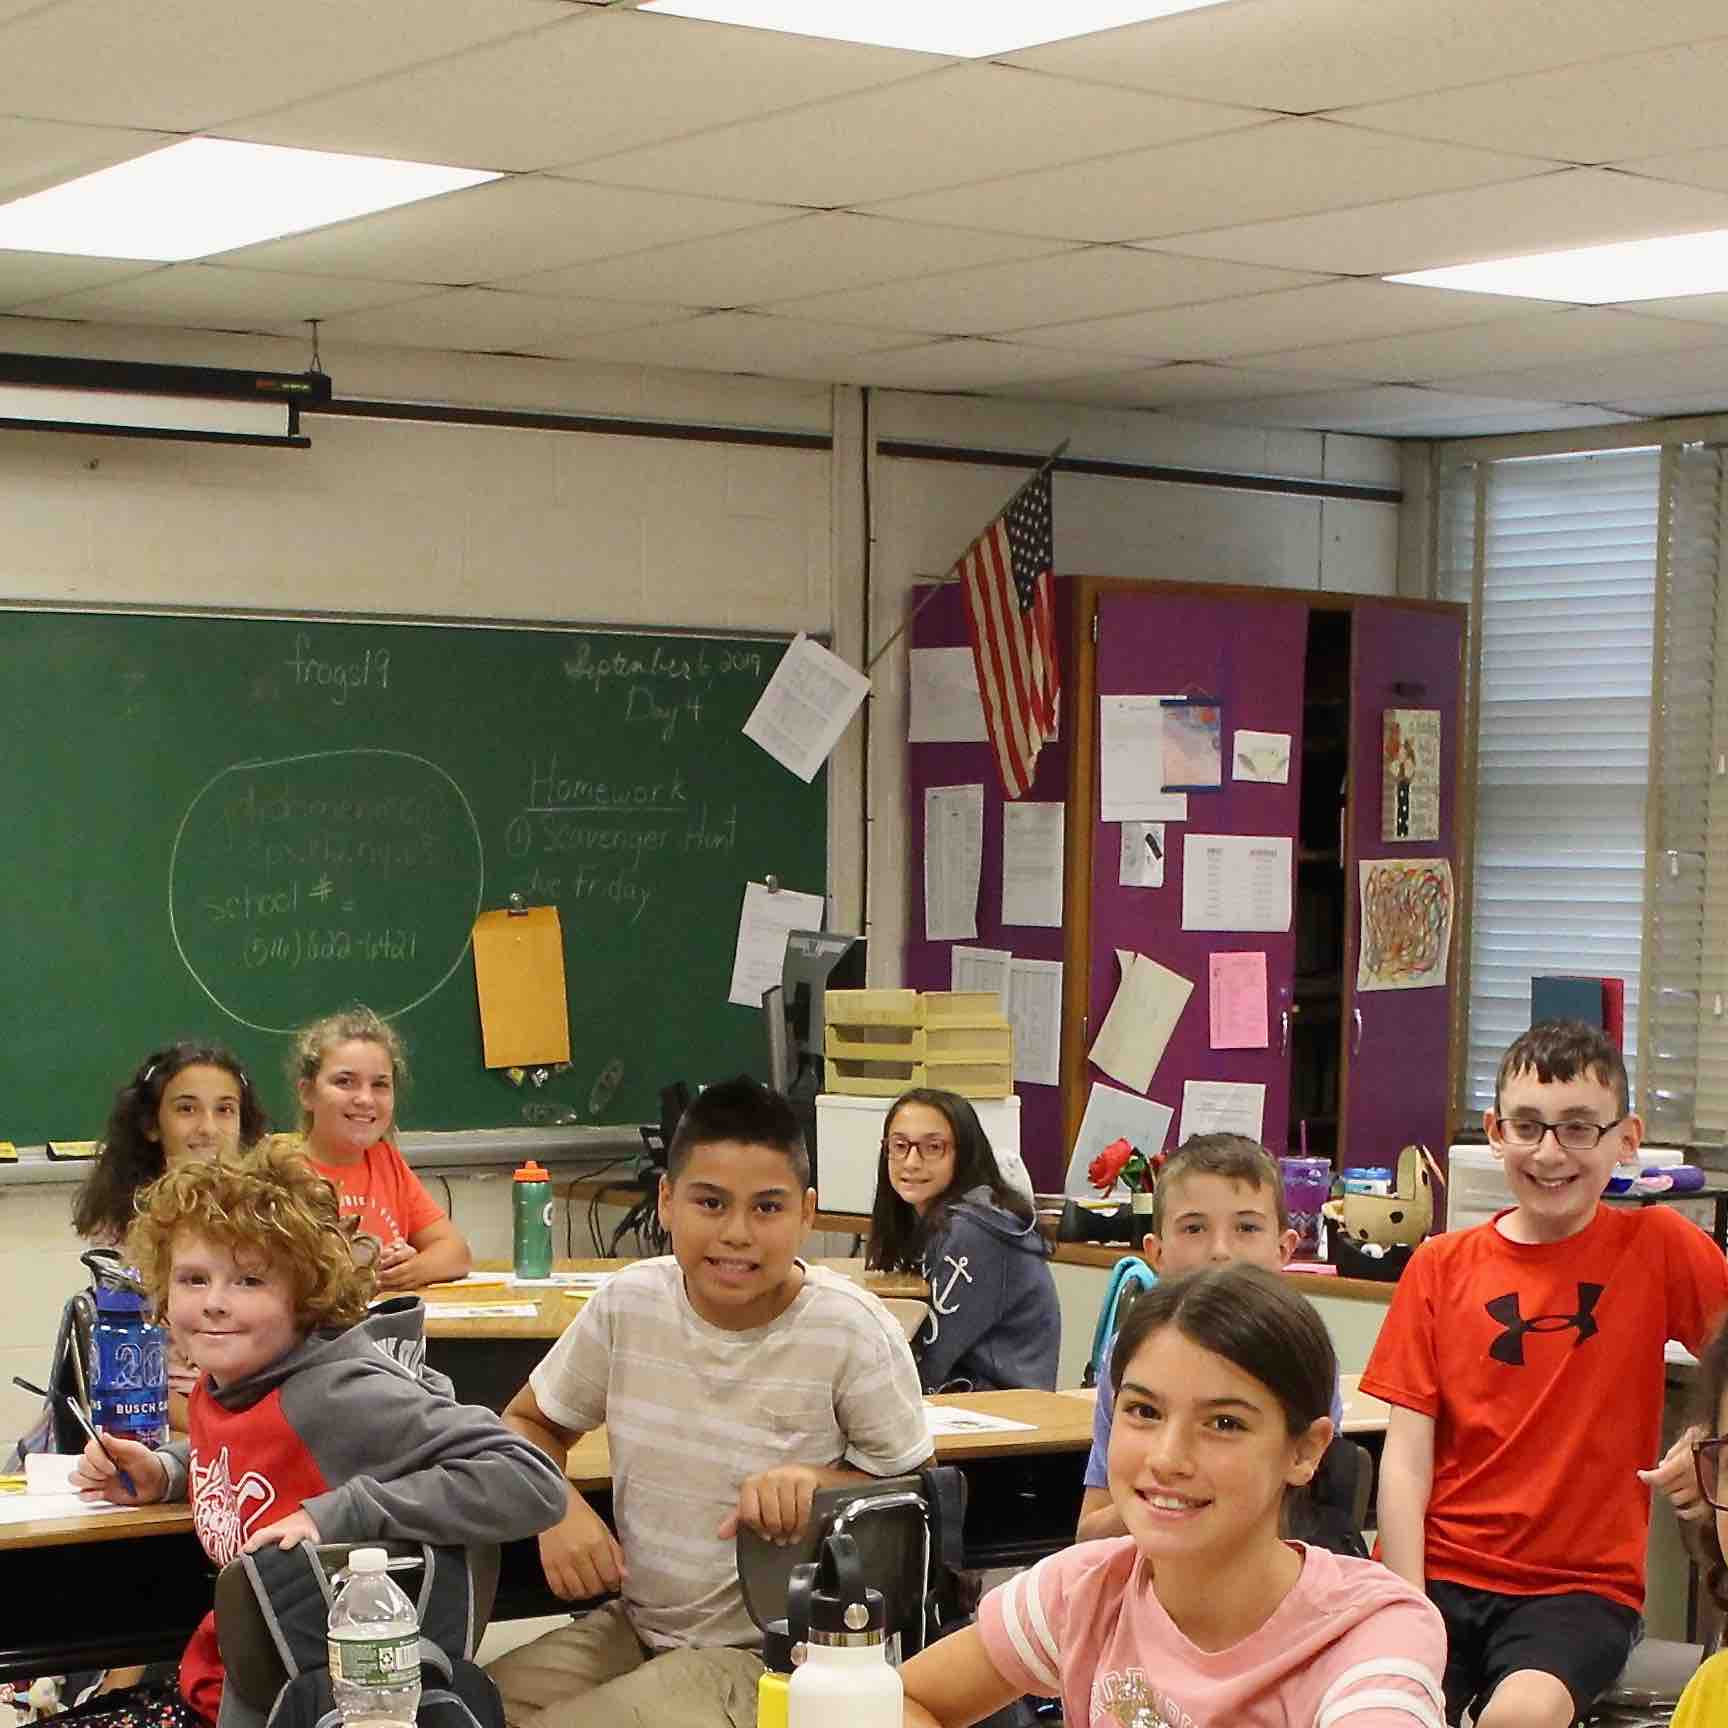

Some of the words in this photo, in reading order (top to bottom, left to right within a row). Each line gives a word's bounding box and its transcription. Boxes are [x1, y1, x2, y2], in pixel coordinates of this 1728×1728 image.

[283, 631, 391, 705] frogs19
[529, 752, 688, 808] Homework
[542, 814, 668, 872] Scavenger
[678, 801, 737, 851] Hunt
[204, 880, 298, 922] school
[116, 1403, 156, 1415] BUSCH
